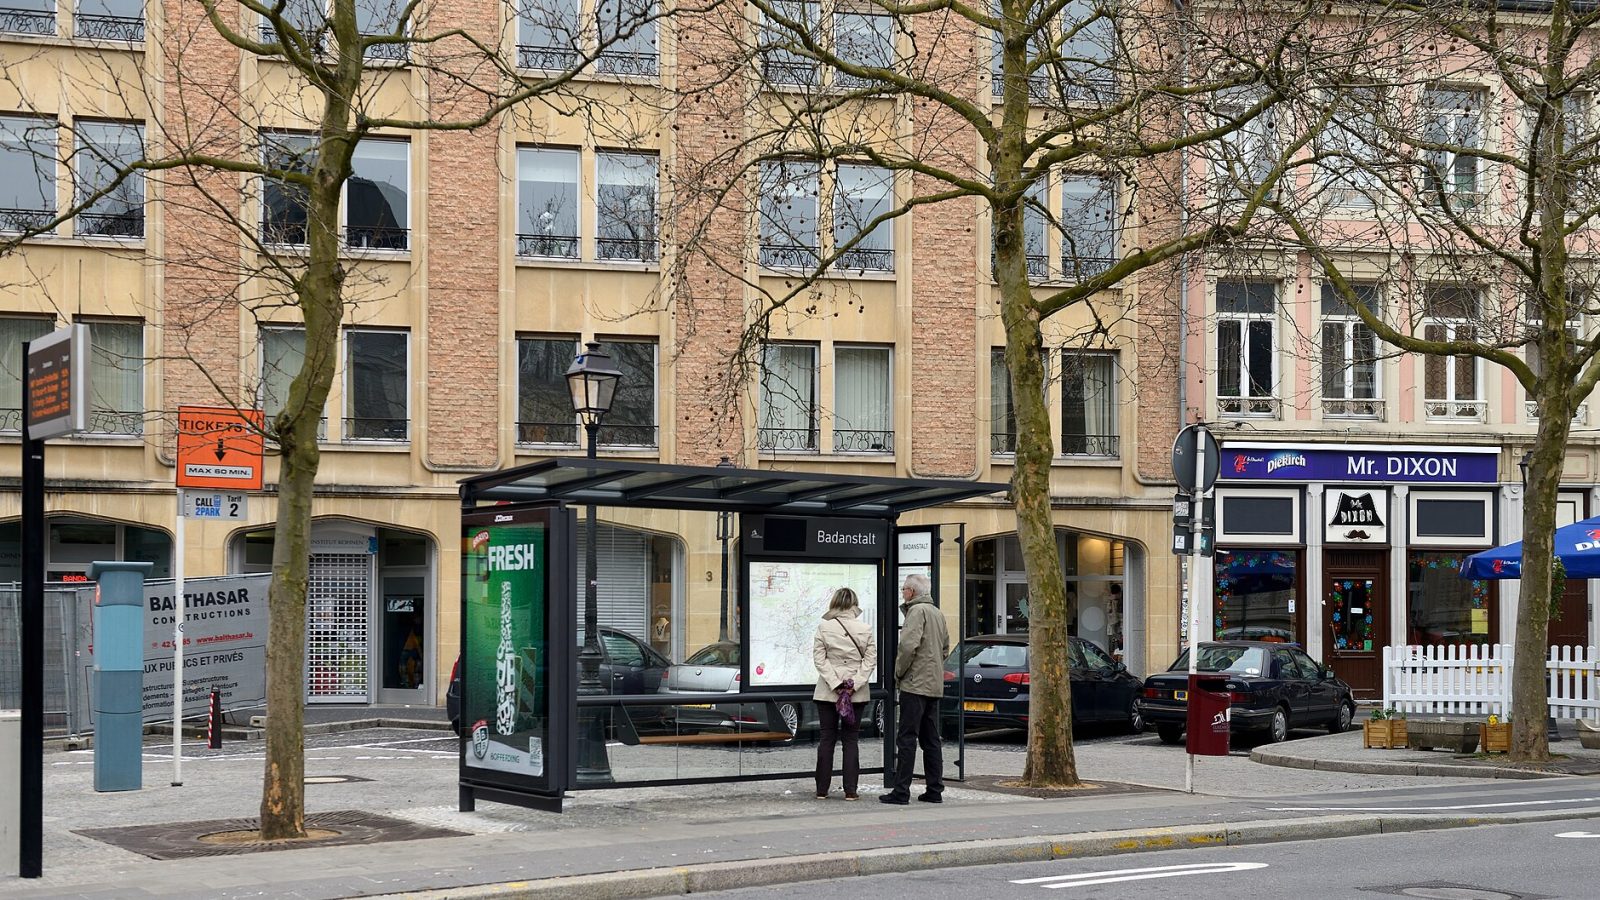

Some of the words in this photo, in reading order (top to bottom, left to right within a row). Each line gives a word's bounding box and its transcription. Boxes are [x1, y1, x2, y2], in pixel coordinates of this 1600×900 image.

[181, 420, 243, 432] TICKETS
[1267, 454, 1306, 473] Diekirch
[1347, 456, 1379, 475] Mr.
[1387, 457, 1457, 477] DIXON
[195, 497, 213, 507] CALL
[195, 507, 221, 517] 2PARK
[229, 503, 239, 517] 2
[1340, 509, 1373, 523] DIXON
[817, 530, 876, 545] Badanstalt
[488, 543, 534, 571] FRESH
[705, 570, 713, 581] 3
[152, 608, 251, 625] CONTRUCTIONS
[159, 657, 198, 672] PUBICS
[200, 656, 212, 666] ET
[213, 651, 244, 664] PRIVÉS
